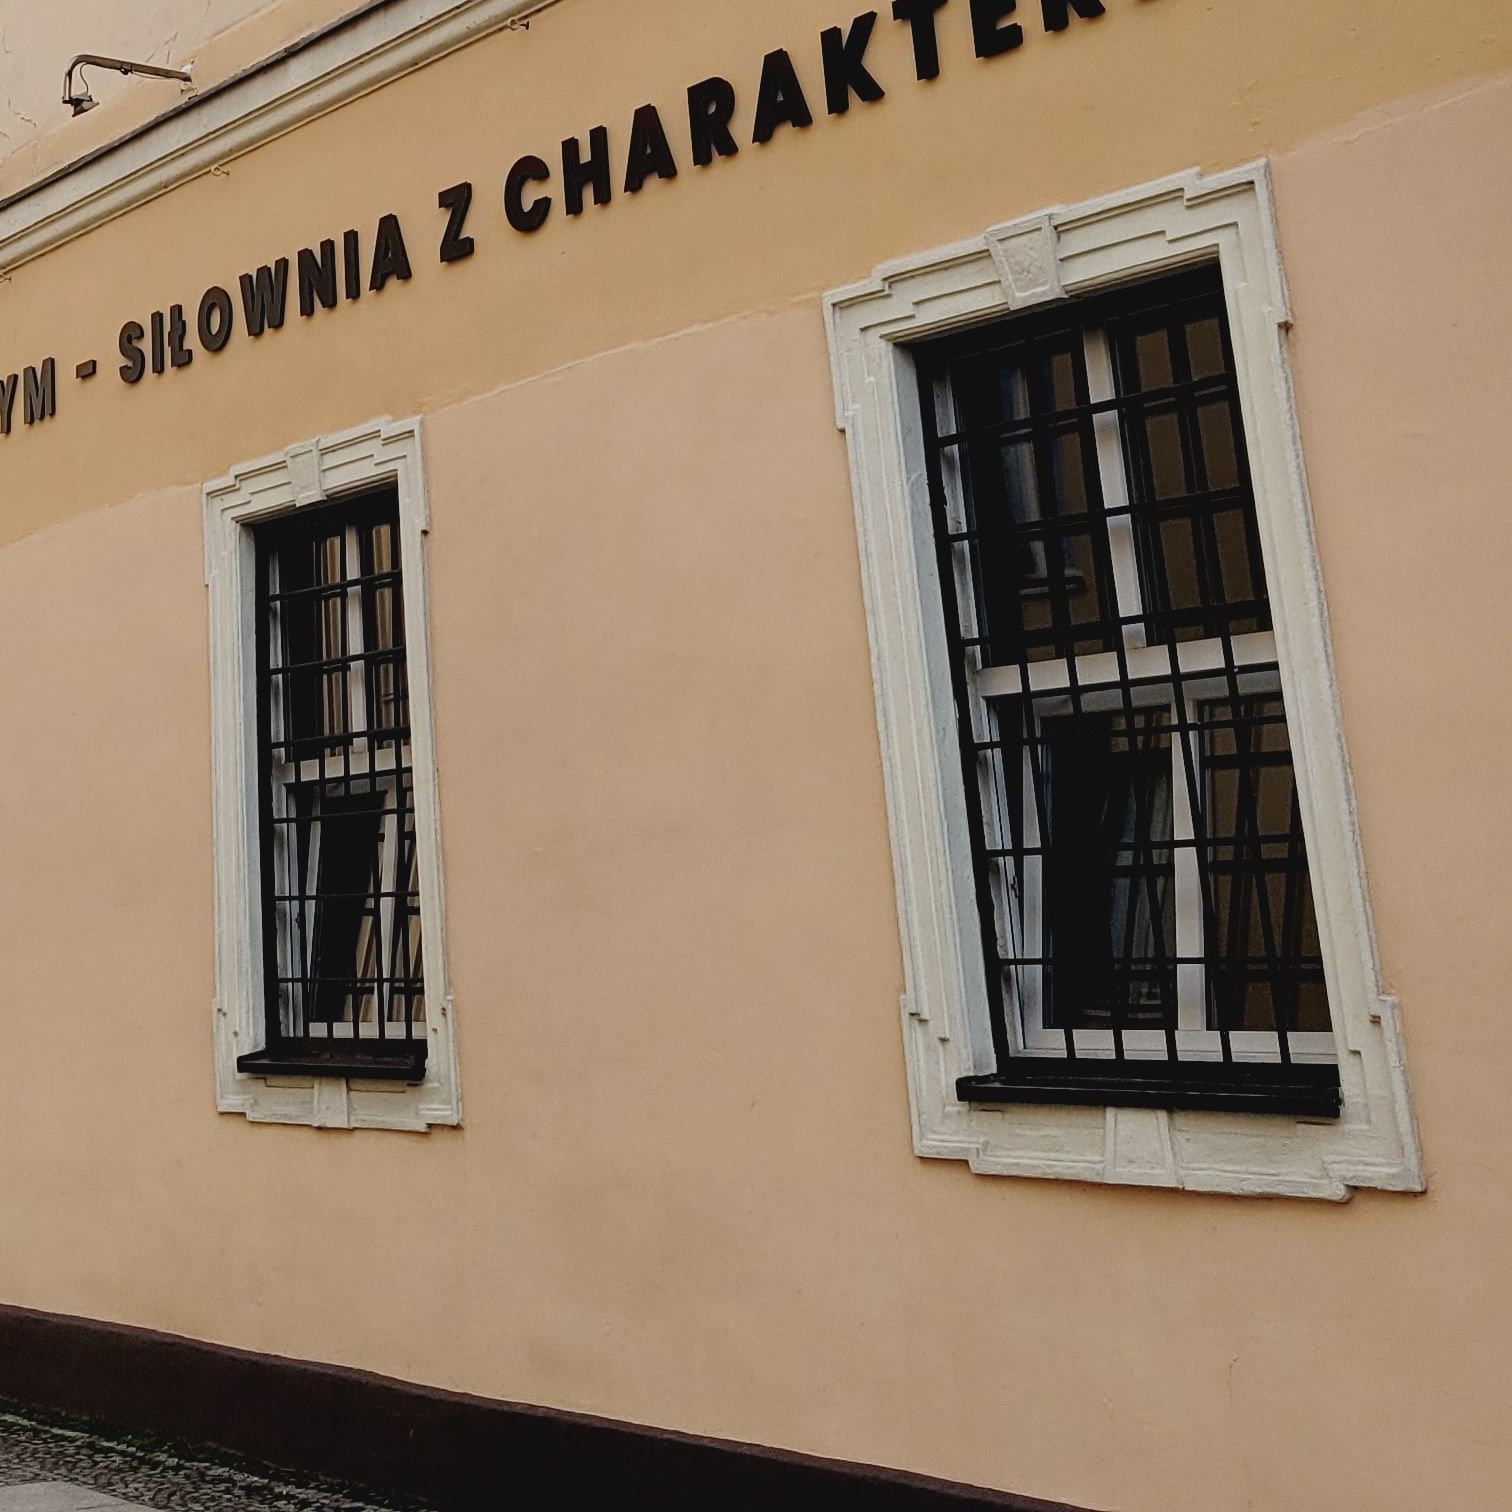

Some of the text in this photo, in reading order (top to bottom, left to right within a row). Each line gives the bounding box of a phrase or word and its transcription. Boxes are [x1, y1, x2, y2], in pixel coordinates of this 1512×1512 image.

[74, 359, 98, 382] -
[118, 212, 414, 387] SIŁOWNIA
[437, 181, 475, 266] Z
